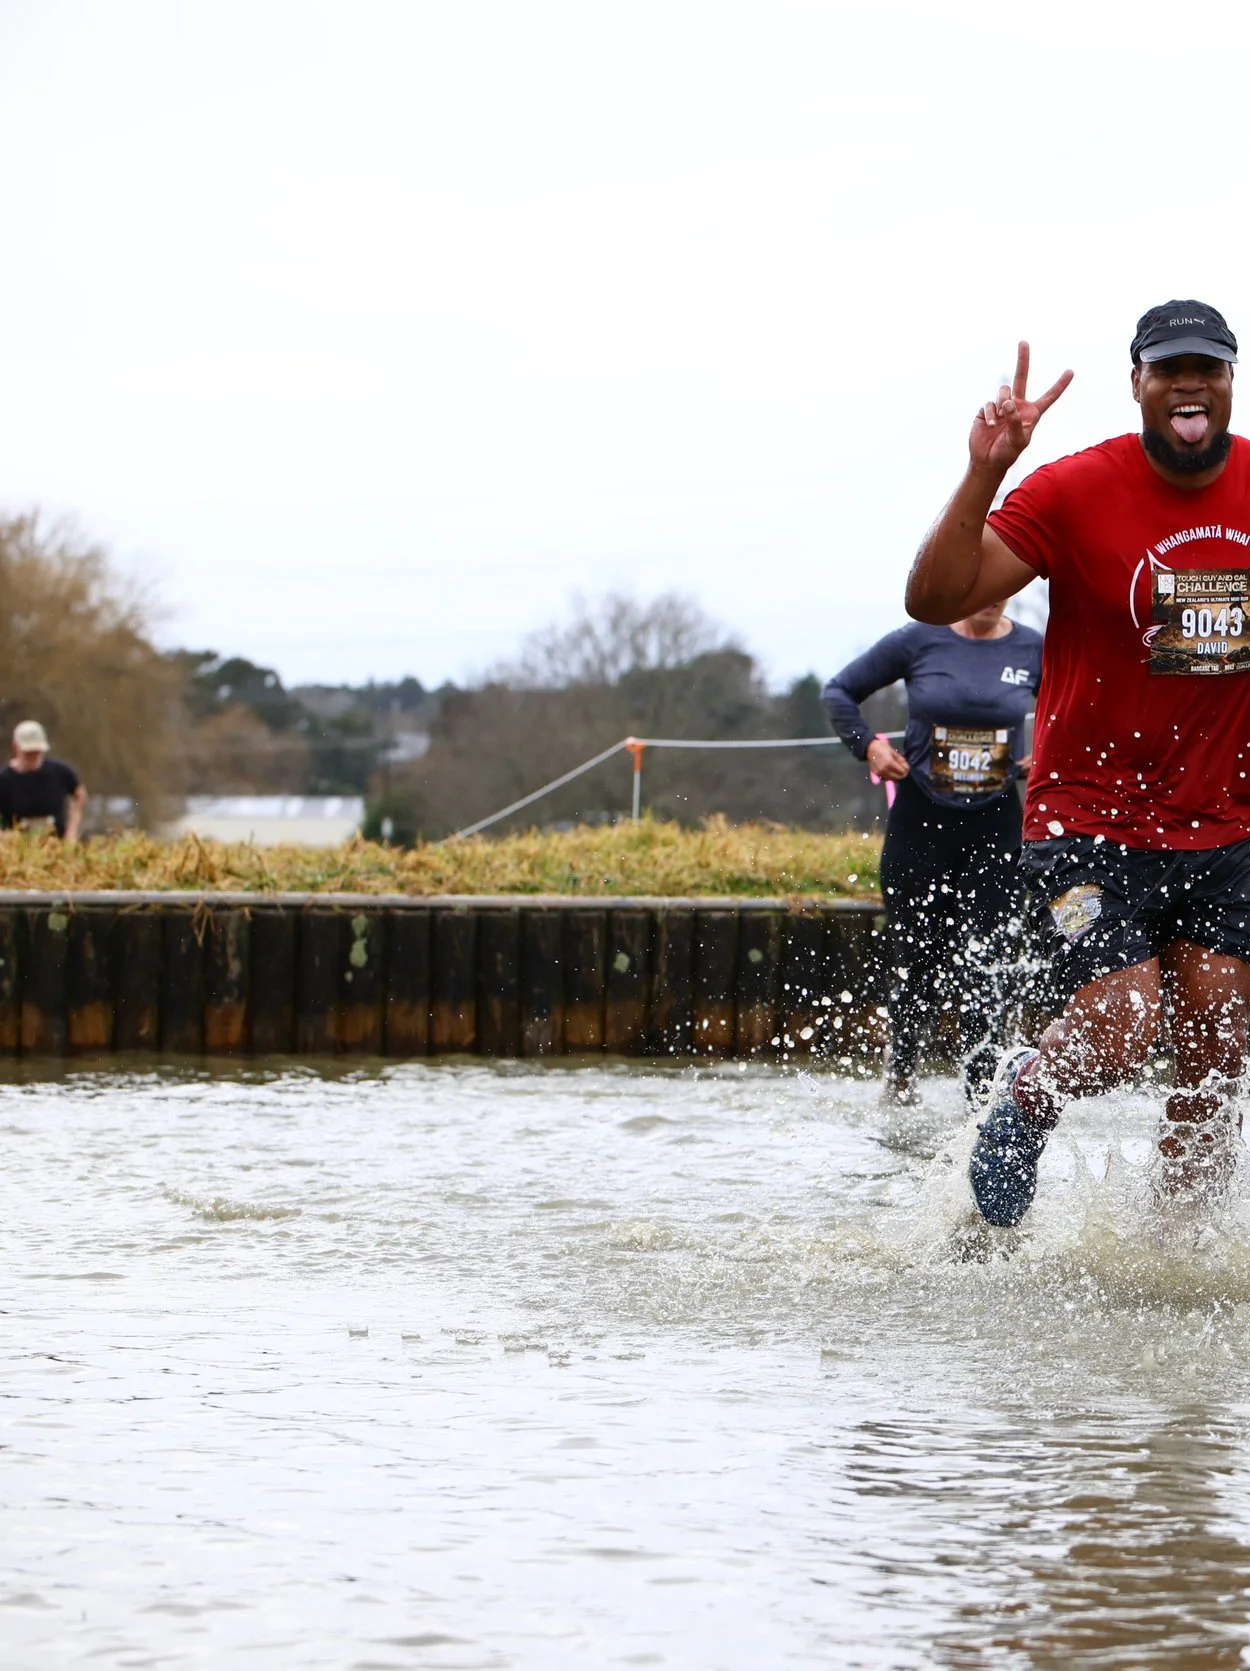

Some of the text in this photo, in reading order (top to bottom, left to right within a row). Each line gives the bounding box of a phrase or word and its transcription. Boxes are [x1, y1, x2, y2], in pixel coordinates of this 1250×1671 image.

[1169, 317, 1193, 327] RUN
[1154, 525, 1222, 555] WHANGAMATĀ
[1225, 527, 1250, 546] WHAI
[1176, 581, 1248, 593] CHALLENGE
[1181, 607, 1243, 639] 9043
[1197, 642, 1228, 655] DAVID
[1000, 666, 1030, 685] AF
[948, 749, 993, 771] 9042
